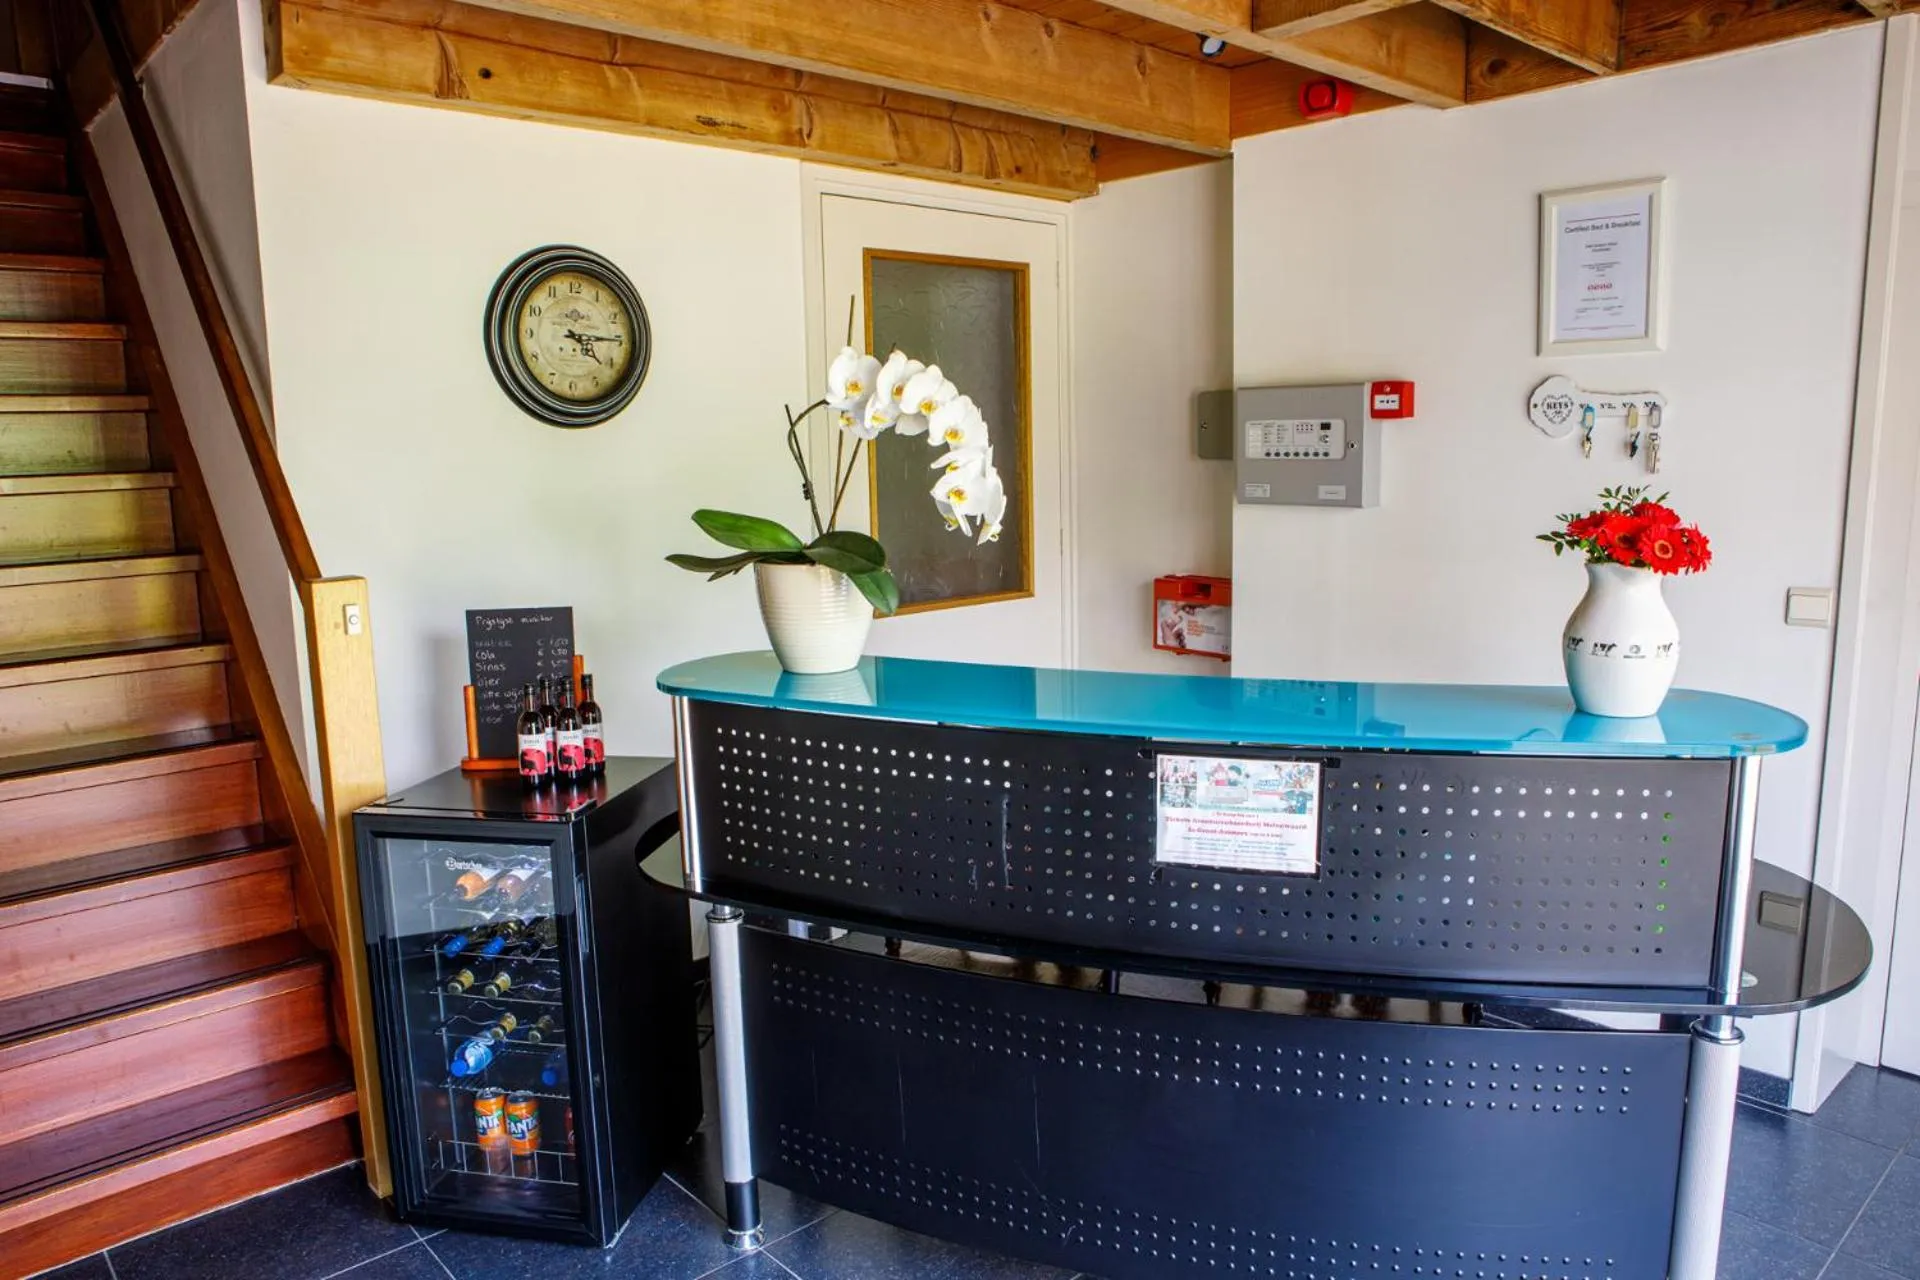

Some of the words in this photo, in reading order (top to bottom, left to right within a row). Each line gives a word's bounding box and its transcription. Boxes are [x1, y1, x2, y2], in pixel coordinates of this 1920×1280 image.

[548, 285, 557, 298] 11
[568, 281, 582, 294] 12
[595, 290, 600, 302] 1
[529, 305, 542, 317] 10
[609, 312, 618, 324] 2
[525, 327, 534, 339] 9
[531, 351, 539, 361] 8
[605, 357, 614, 369] 4
[549, 372, 557, 385] 7
[592, 376, 599, 388] 5
[569, 380, 577, 392] 6
[1546, 401, 1569, 410] KEYS
[475, 649, 496, 660] Cola
[475, 661, 507, 672] Sinas
